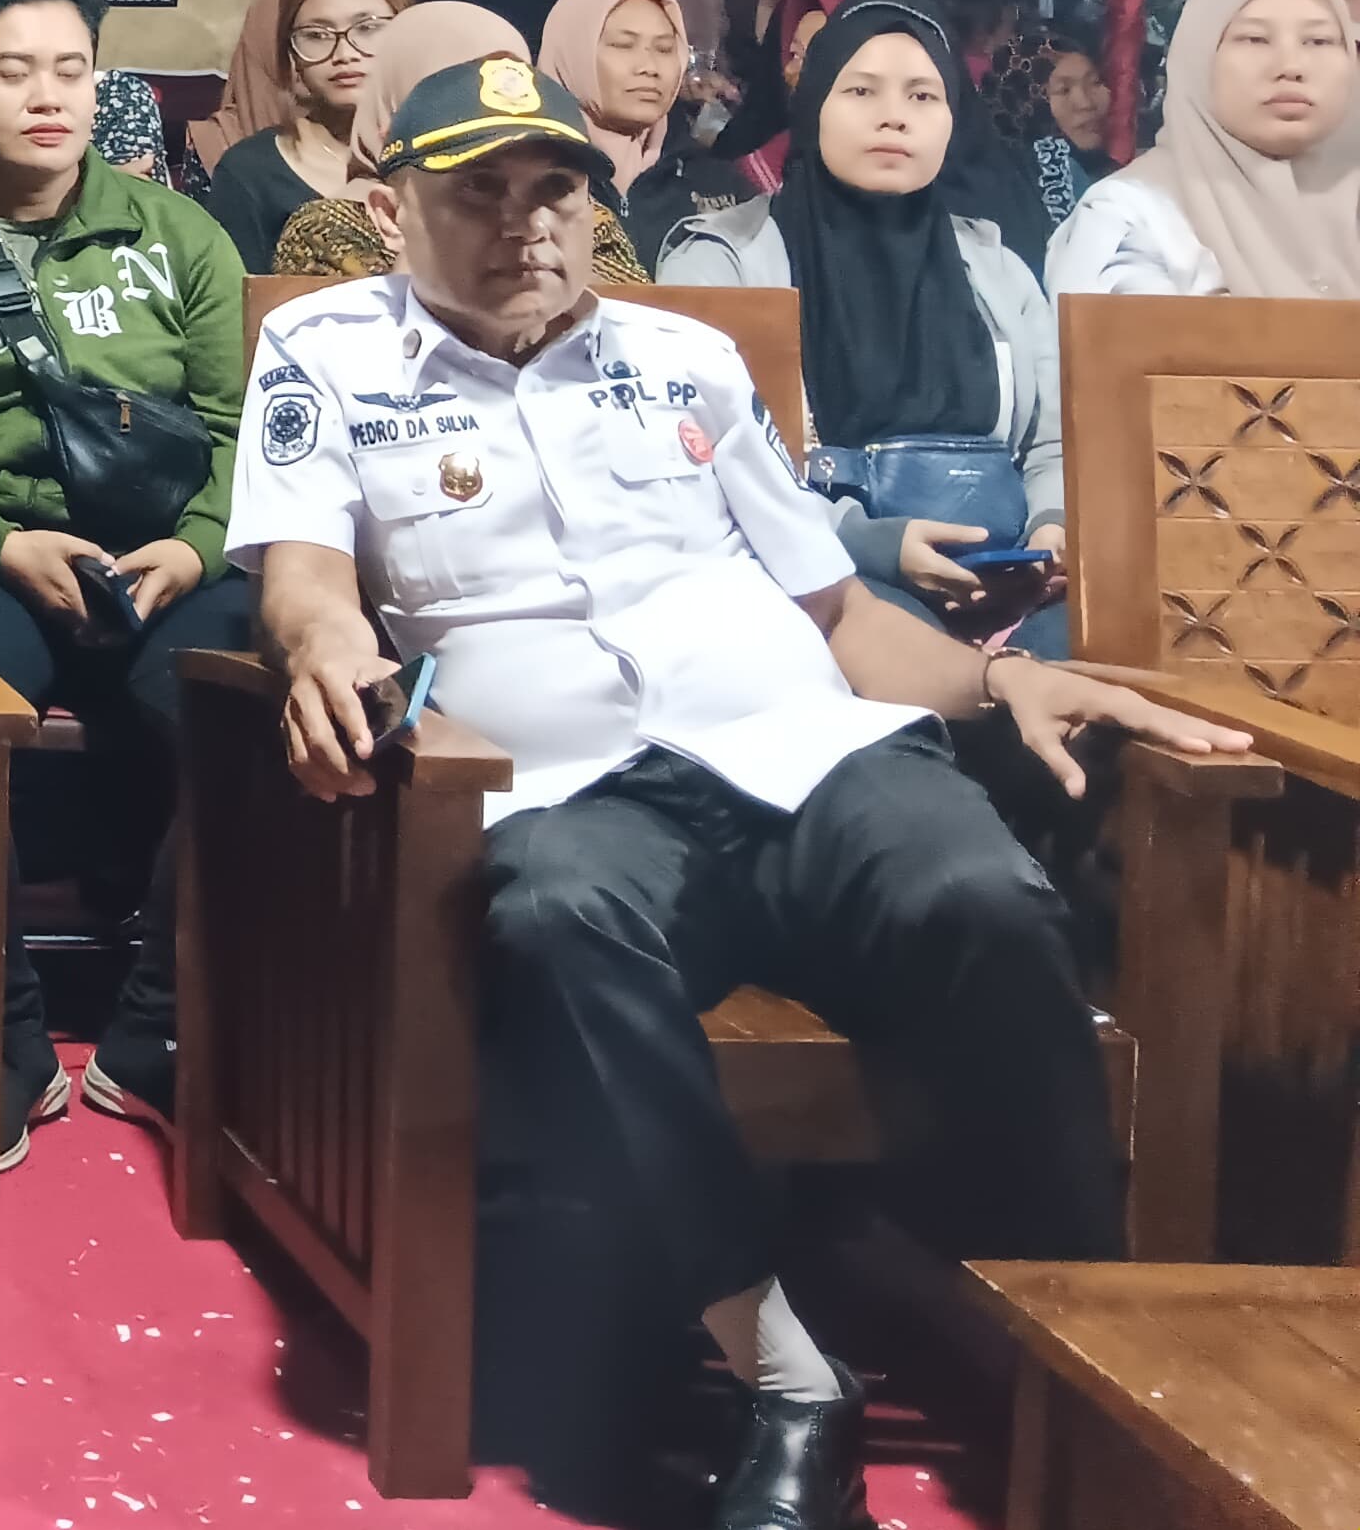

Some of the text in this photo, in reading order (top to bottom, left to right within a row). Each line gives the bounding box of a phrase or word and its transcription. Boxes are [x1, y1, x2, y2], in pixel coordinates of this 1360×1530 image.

[666, 381, 697, 407] PP
[349, 414, 480, 448] PEDRO DA SILVA
